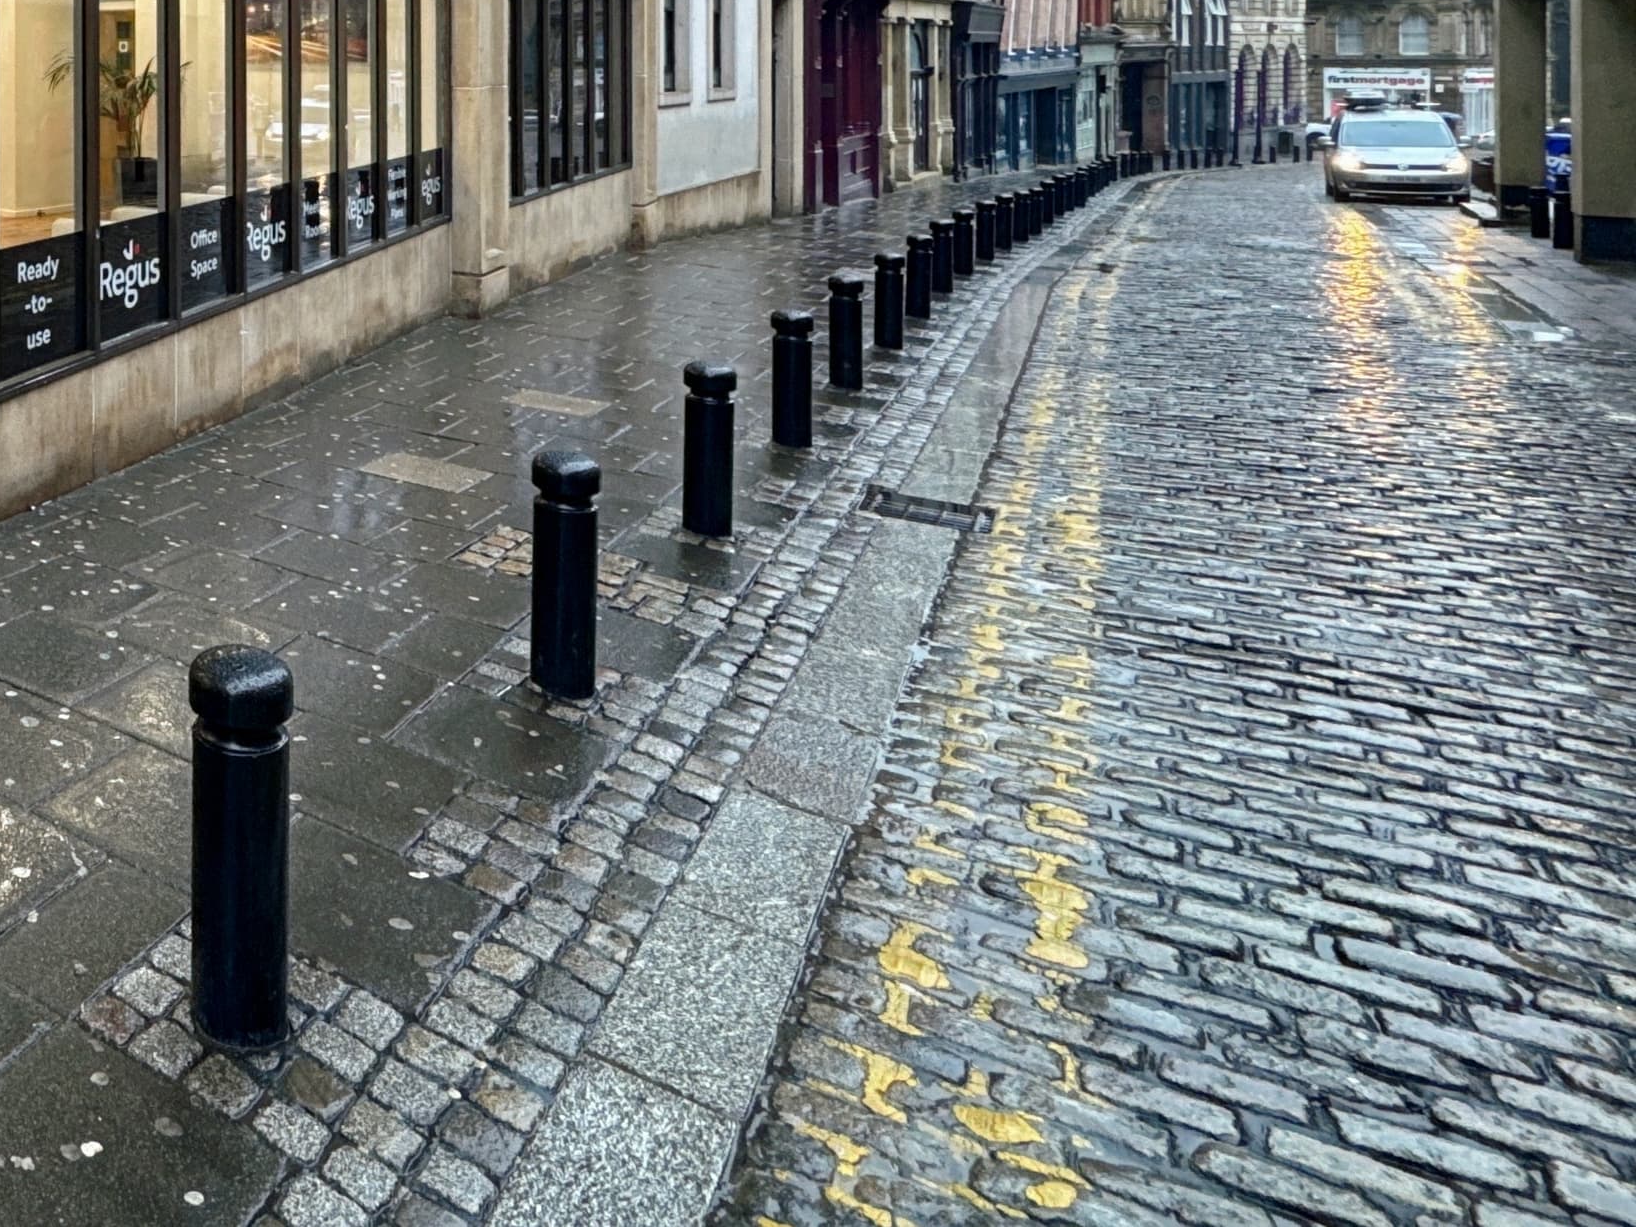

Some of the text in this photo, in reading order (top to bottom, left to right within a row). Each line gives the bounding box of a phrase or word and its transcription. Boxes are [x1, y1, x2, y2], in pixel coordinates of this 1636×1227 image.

[190, 229, 218, 249] Office
[17, 254, 60, 284] Ready
[190, 257, 218, 281] Space
[100, 257, 160, 309] Regus
[24, 294, 53, 314] -to-
[27, 328, 51, 350] use
